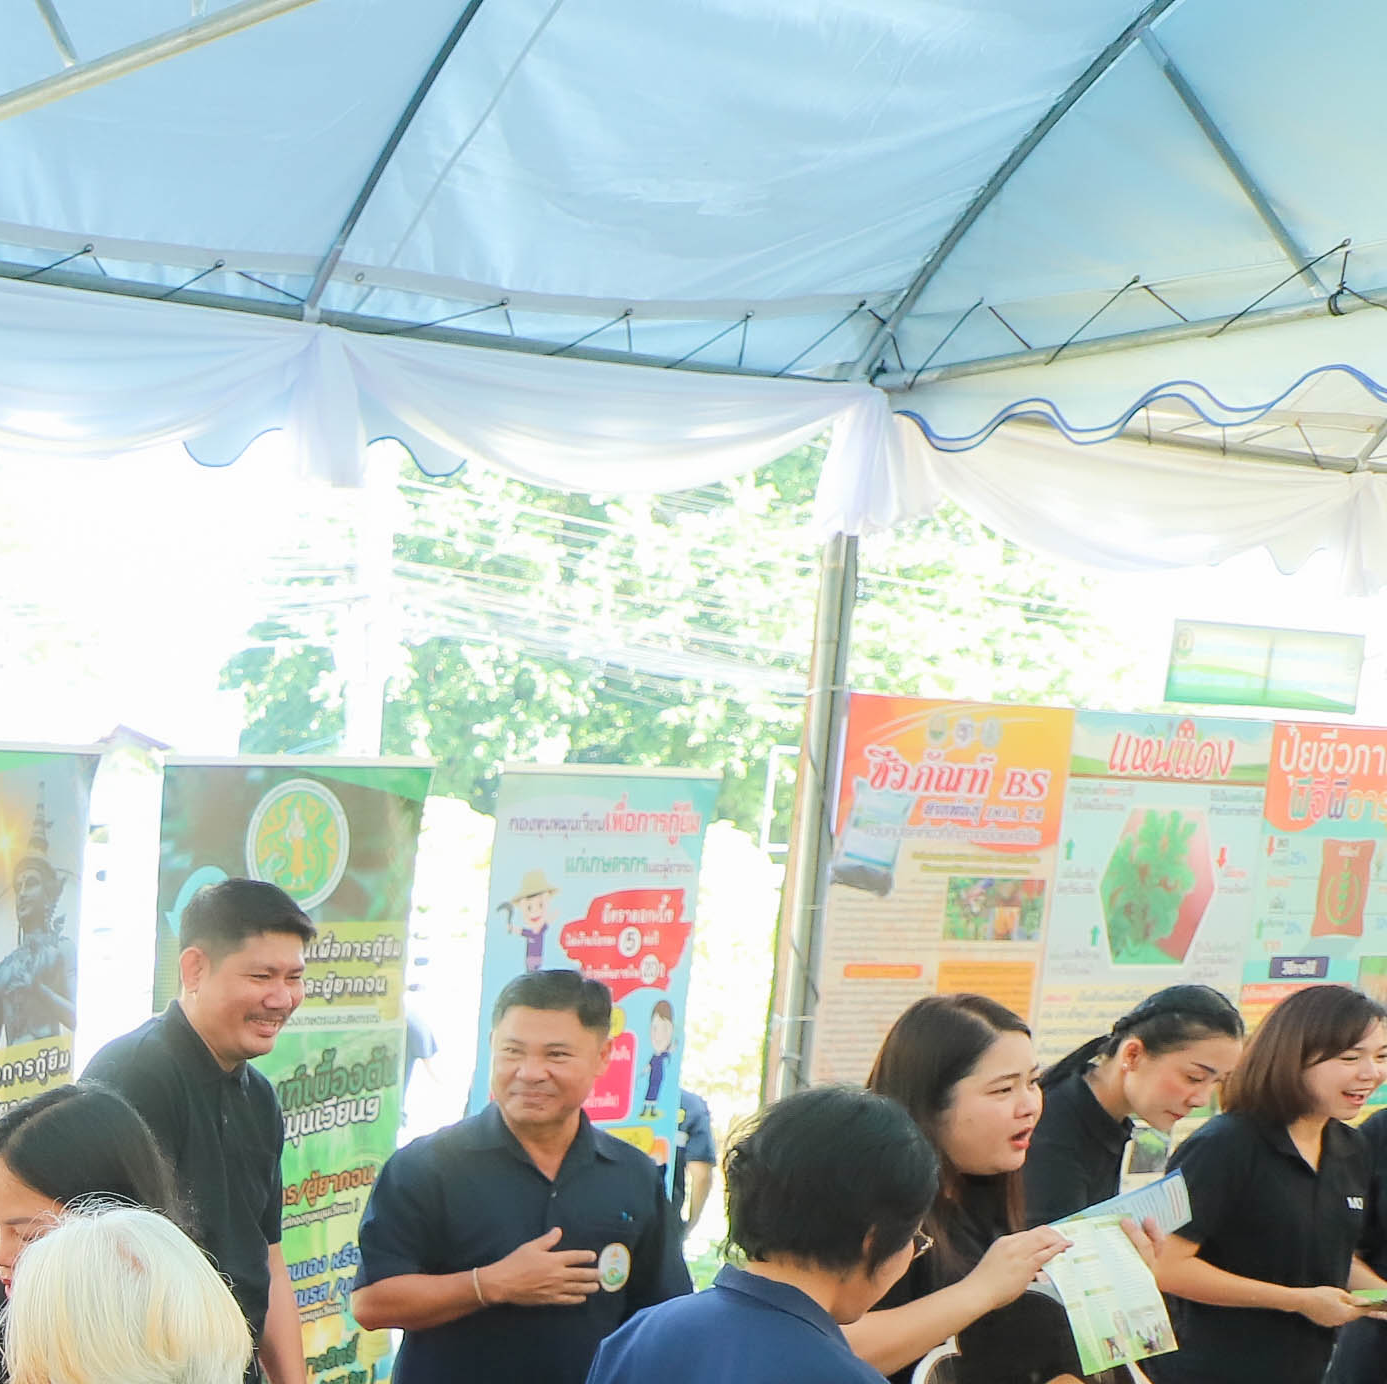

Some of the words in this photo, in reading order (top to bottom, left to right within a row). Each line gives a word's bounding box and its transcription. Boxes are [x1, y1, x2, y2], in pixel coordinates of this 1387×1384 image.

[1107, 731, 1236, 778] แหนแดง
[1002, 769, 1051, 798] BS
